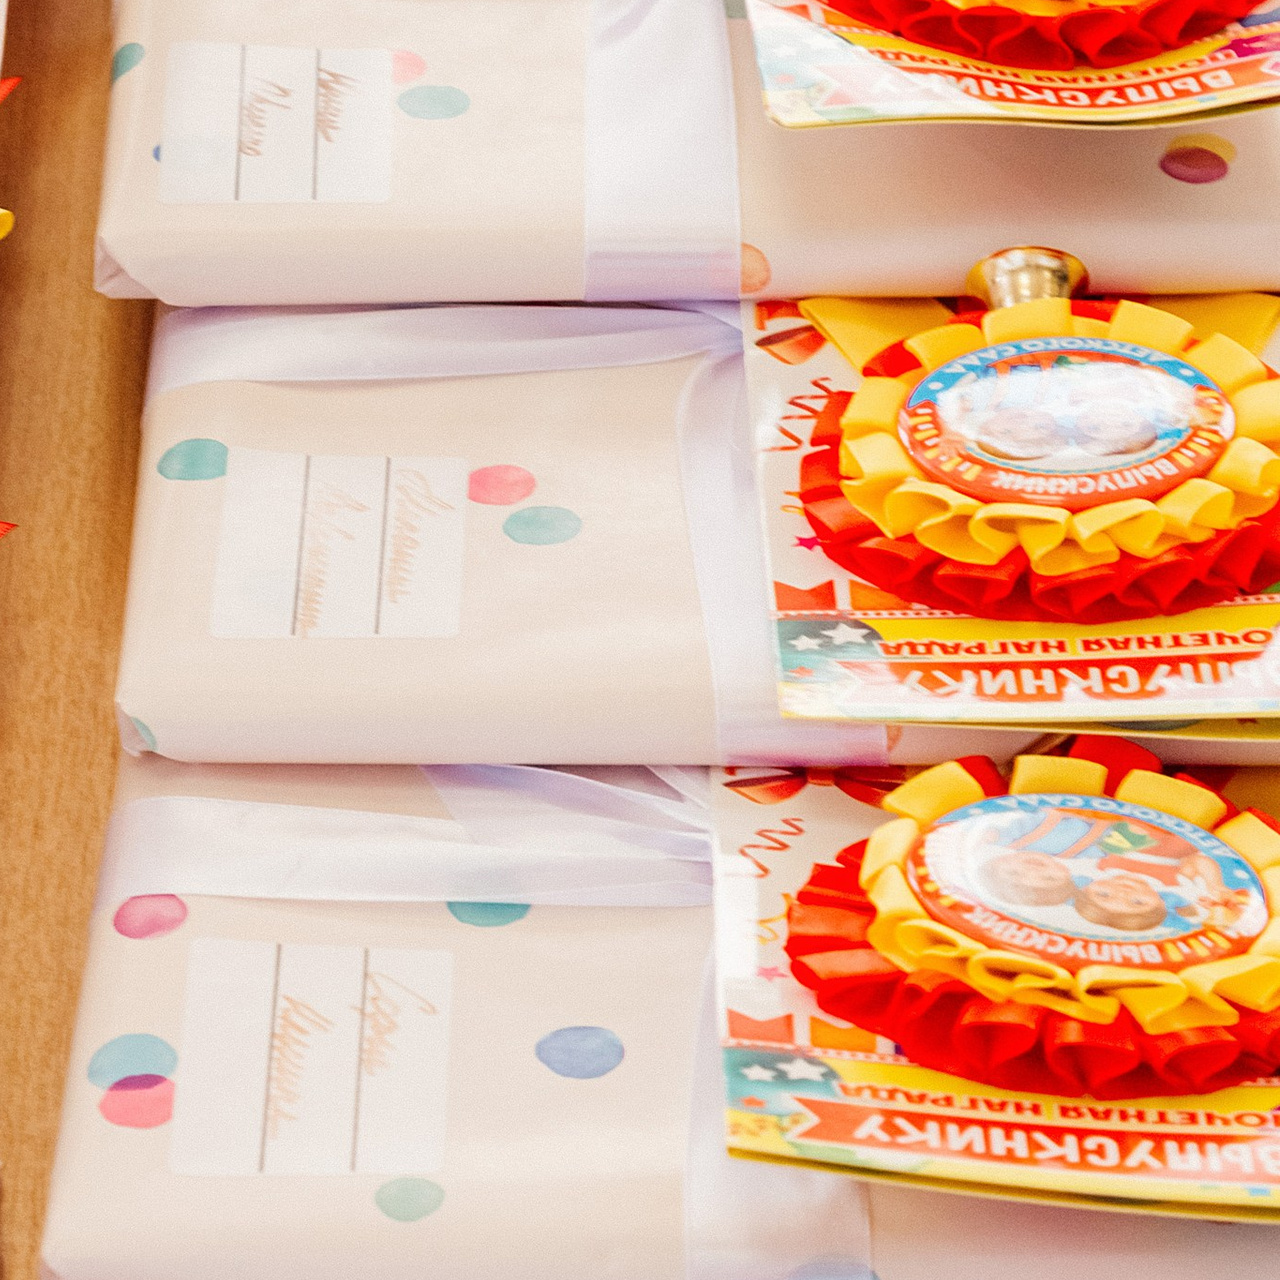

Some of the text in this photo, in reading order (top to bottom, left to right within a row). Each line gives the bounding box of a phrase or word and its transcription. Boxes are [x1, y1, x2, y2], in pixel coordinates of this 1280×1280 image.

[876, 70, 1235, 107] ВЫПУСКНИУ
[1022, 337, 1170, 365] ДЕТСКОГО
[990, 458, 1180, 494] ВЫПУСКНИК
[880, 630, 1274, 655] ОЧЕТНАЯ НАГРАДА
[1090, 795, 1240, 859] ДЕТСКОГО
[964, 906, 1164, 964] ВЫПУСКНИК
[839, 1083, 1042, 1116] НАГРАДА
